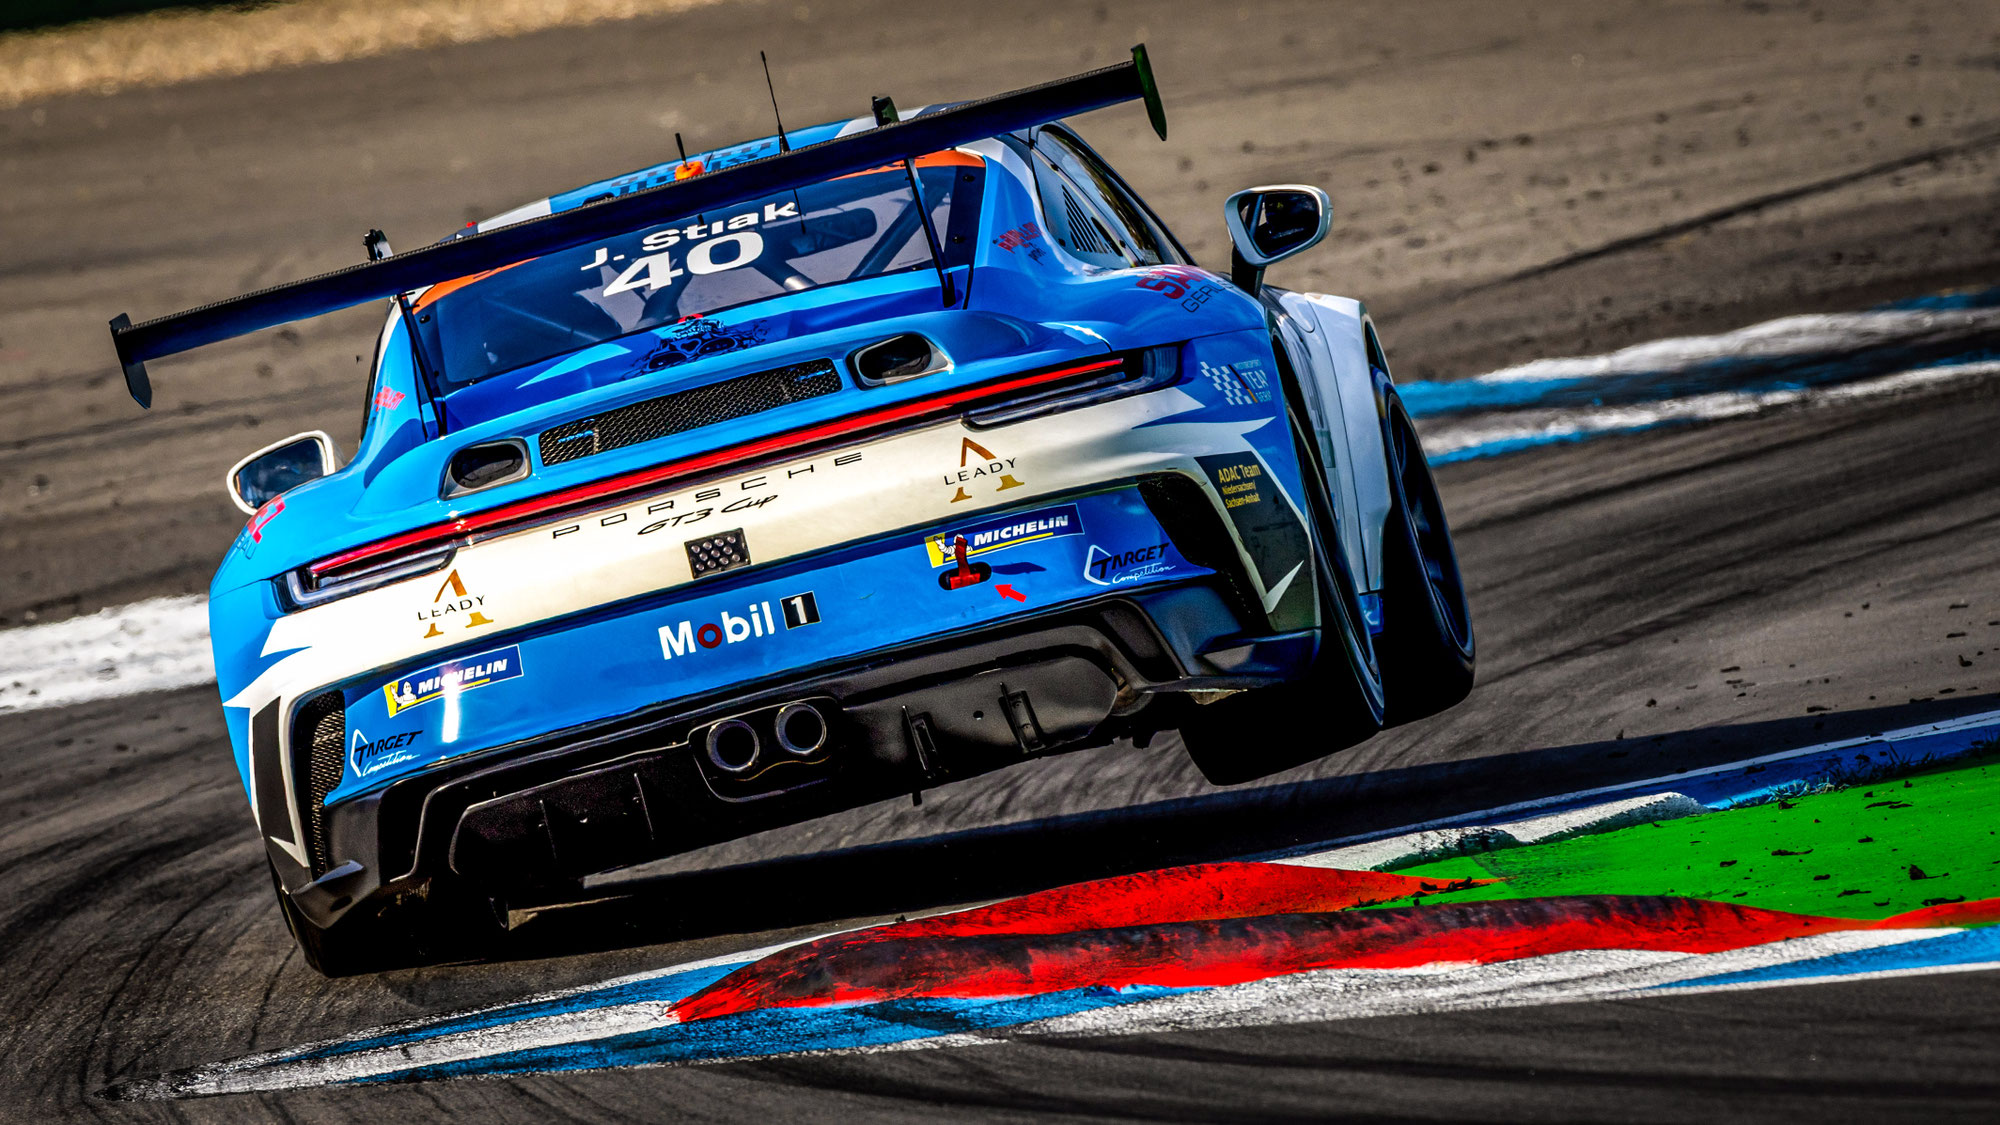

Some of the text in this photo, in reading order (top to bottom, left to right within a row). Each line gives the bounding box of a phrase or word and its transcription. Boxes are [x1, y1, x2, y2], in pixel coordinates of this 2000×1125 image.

[581, 247, 625, 271] J.
[603, 231, 764, 297] 40
[943, 457, 1018, 486] LEADY
[1218, 464, 1261, 483] ADAC Team
[552, 452, 863, 539] PORSCHE
[1225, 493, 1261, 508] Sachsen-Anhalt
[637, 494, 779, 535] GT3 Cup
[974, 514, 1069, 547] MICHELIN
[1091, 542, 1170, 580] TARGET
[1112, 562, 1176, 584] Competition
[418, 595, 486, 621] LEADY
[658, 596, 809, 660] Mobil 1
[418, 659, 508, 694] MICHELIN
[355, 730, 424, 767] TARGET
